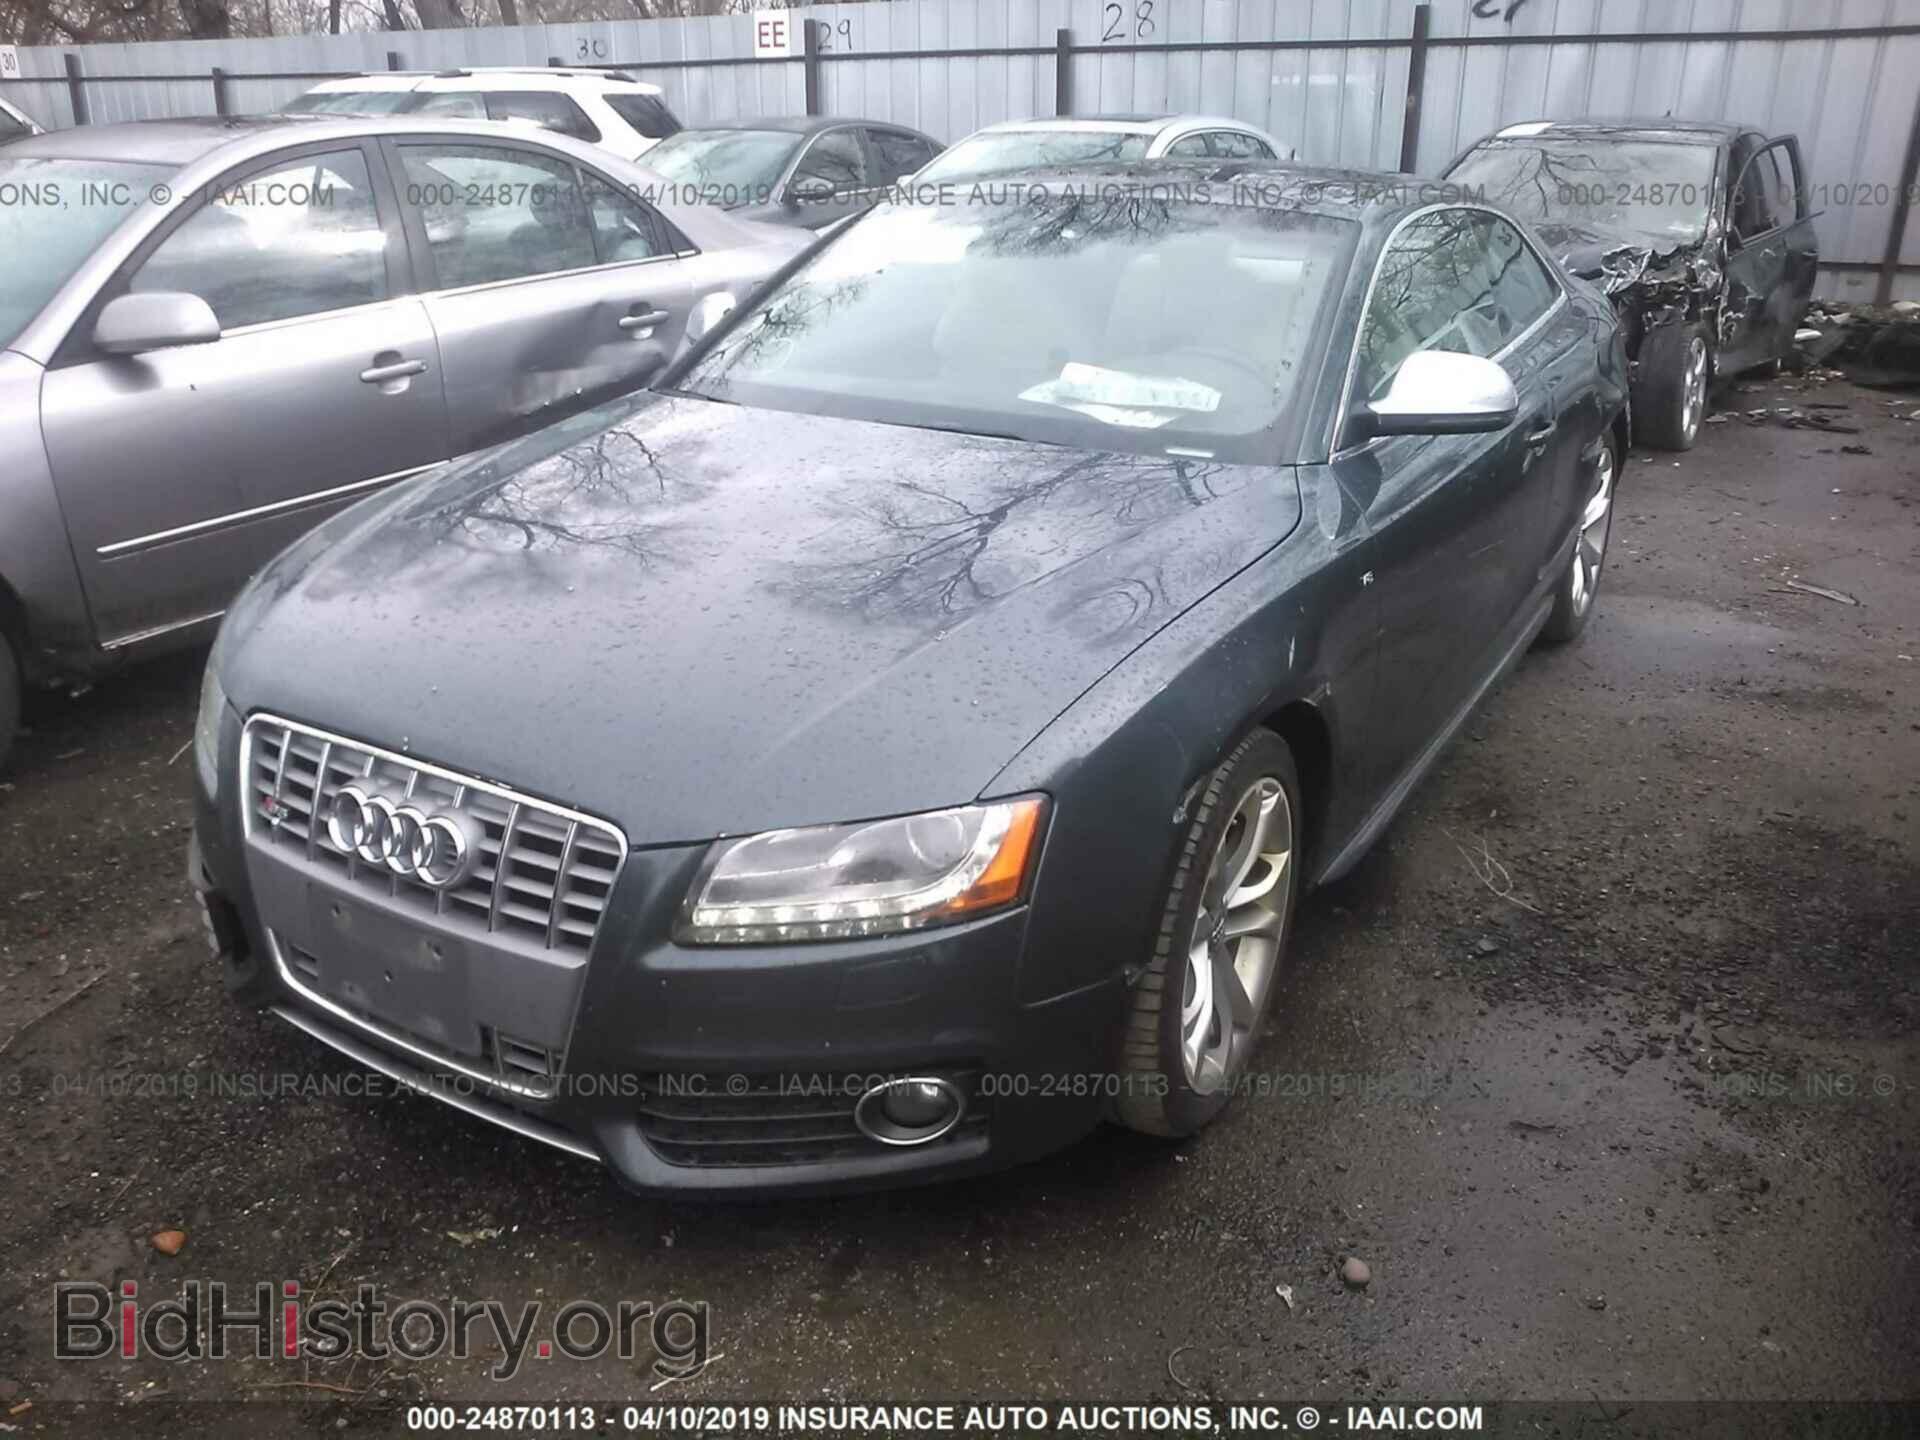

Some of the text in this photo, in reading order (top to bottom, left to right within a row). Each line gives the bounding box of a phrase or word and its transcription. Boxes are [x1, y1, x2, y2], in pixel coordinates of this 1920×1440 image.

[758, 21, 785, 48] EE
[818, 19, 852, 50] 29
[1102, 0, 1155, 41] 28
[576, 37, 608, 59] 30
